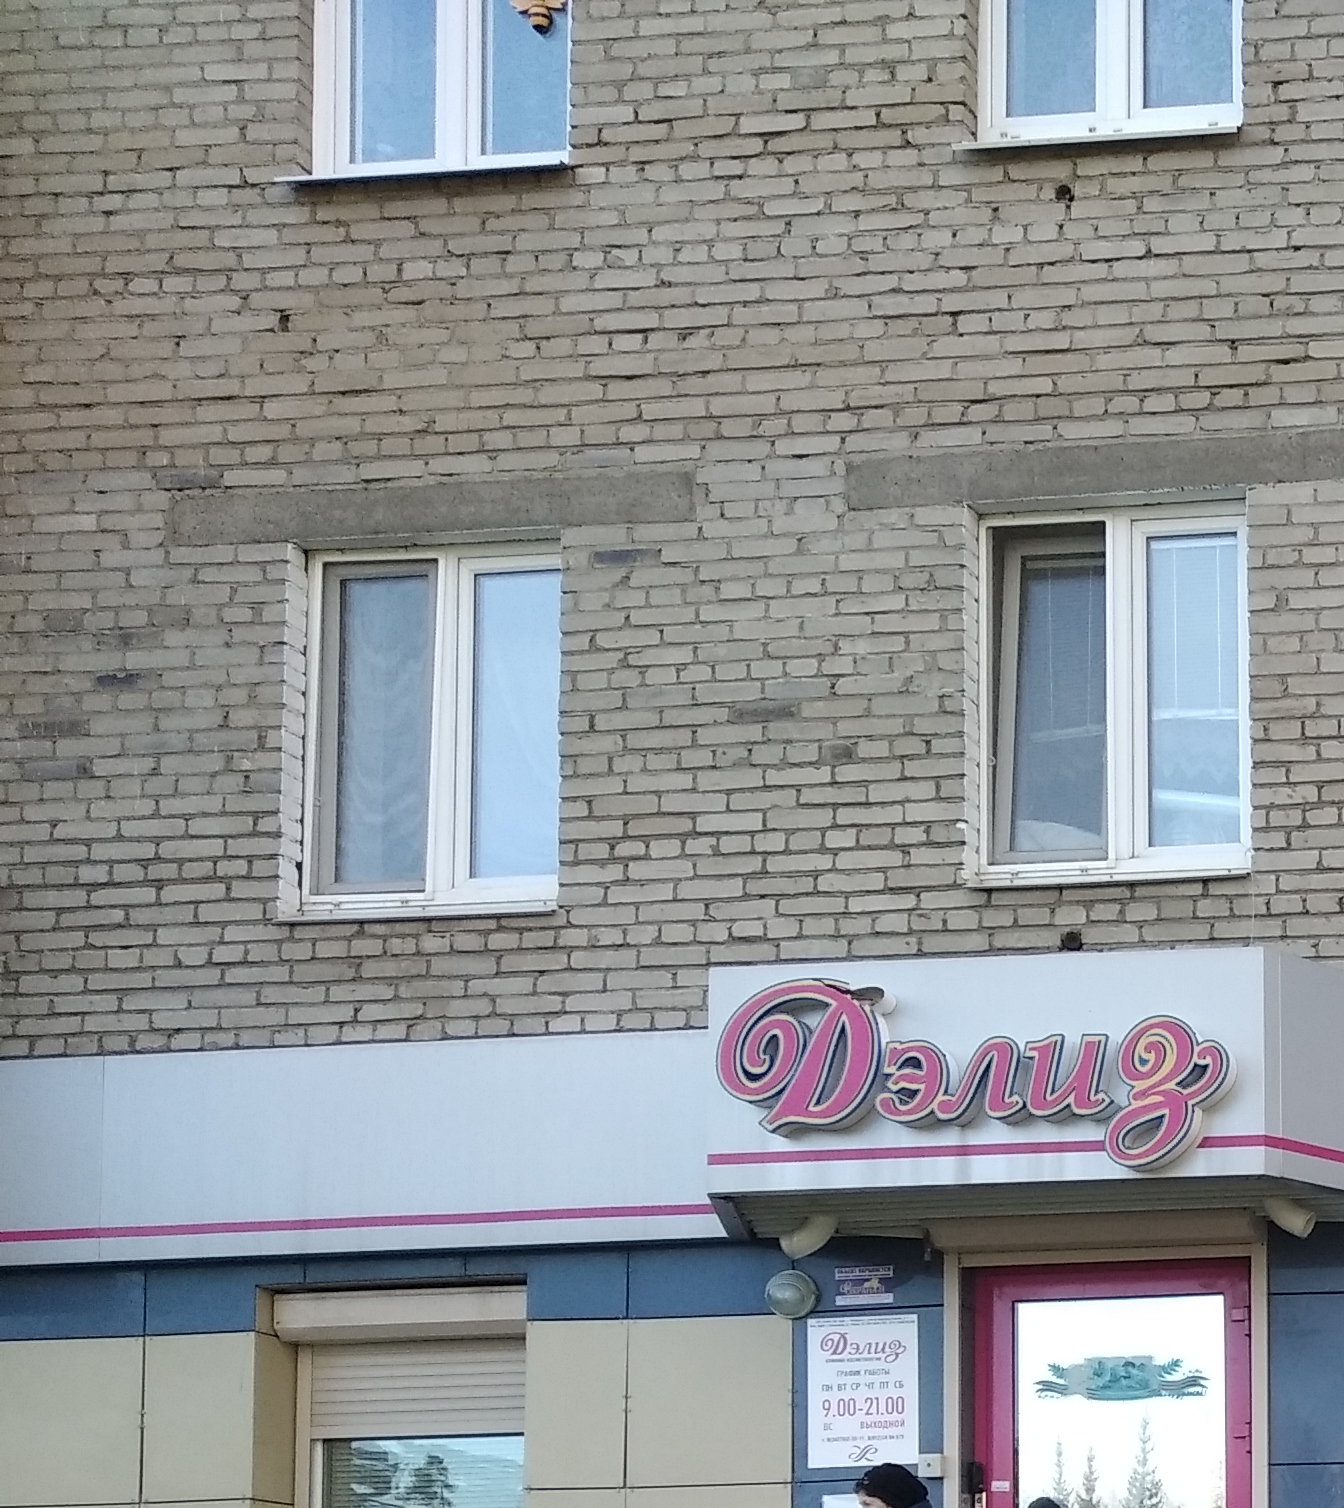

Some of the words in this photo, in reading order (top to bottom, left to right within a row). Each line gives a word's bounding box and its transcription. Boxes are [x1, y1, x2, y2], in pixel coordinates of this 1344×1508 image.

[716, 978, 1238, 1172] Дэлиз
[820, 1331, 907, 1364] Дэлиз
[836, 1369, 861, 1377] ГРАФИК
[863, 1368, 890, 1376] РАБОТЫ
[821, 1383, 833, 1392] ПН
[837, 1383, 847, 1391] ВТ
[850, 1382, 861, 1391] СР
[864, 1381, 875, 1390] ЧТ
[879, 1380, 889, 1389] ПТ
[893, 1380, 904, 1389] СБ
[821, 1395, 905, 1417] 9.00-21.00
[823, 1422, 833, 1431] ВС
[860, 1418, 905, 1430] ВЫХОДНОЙ
